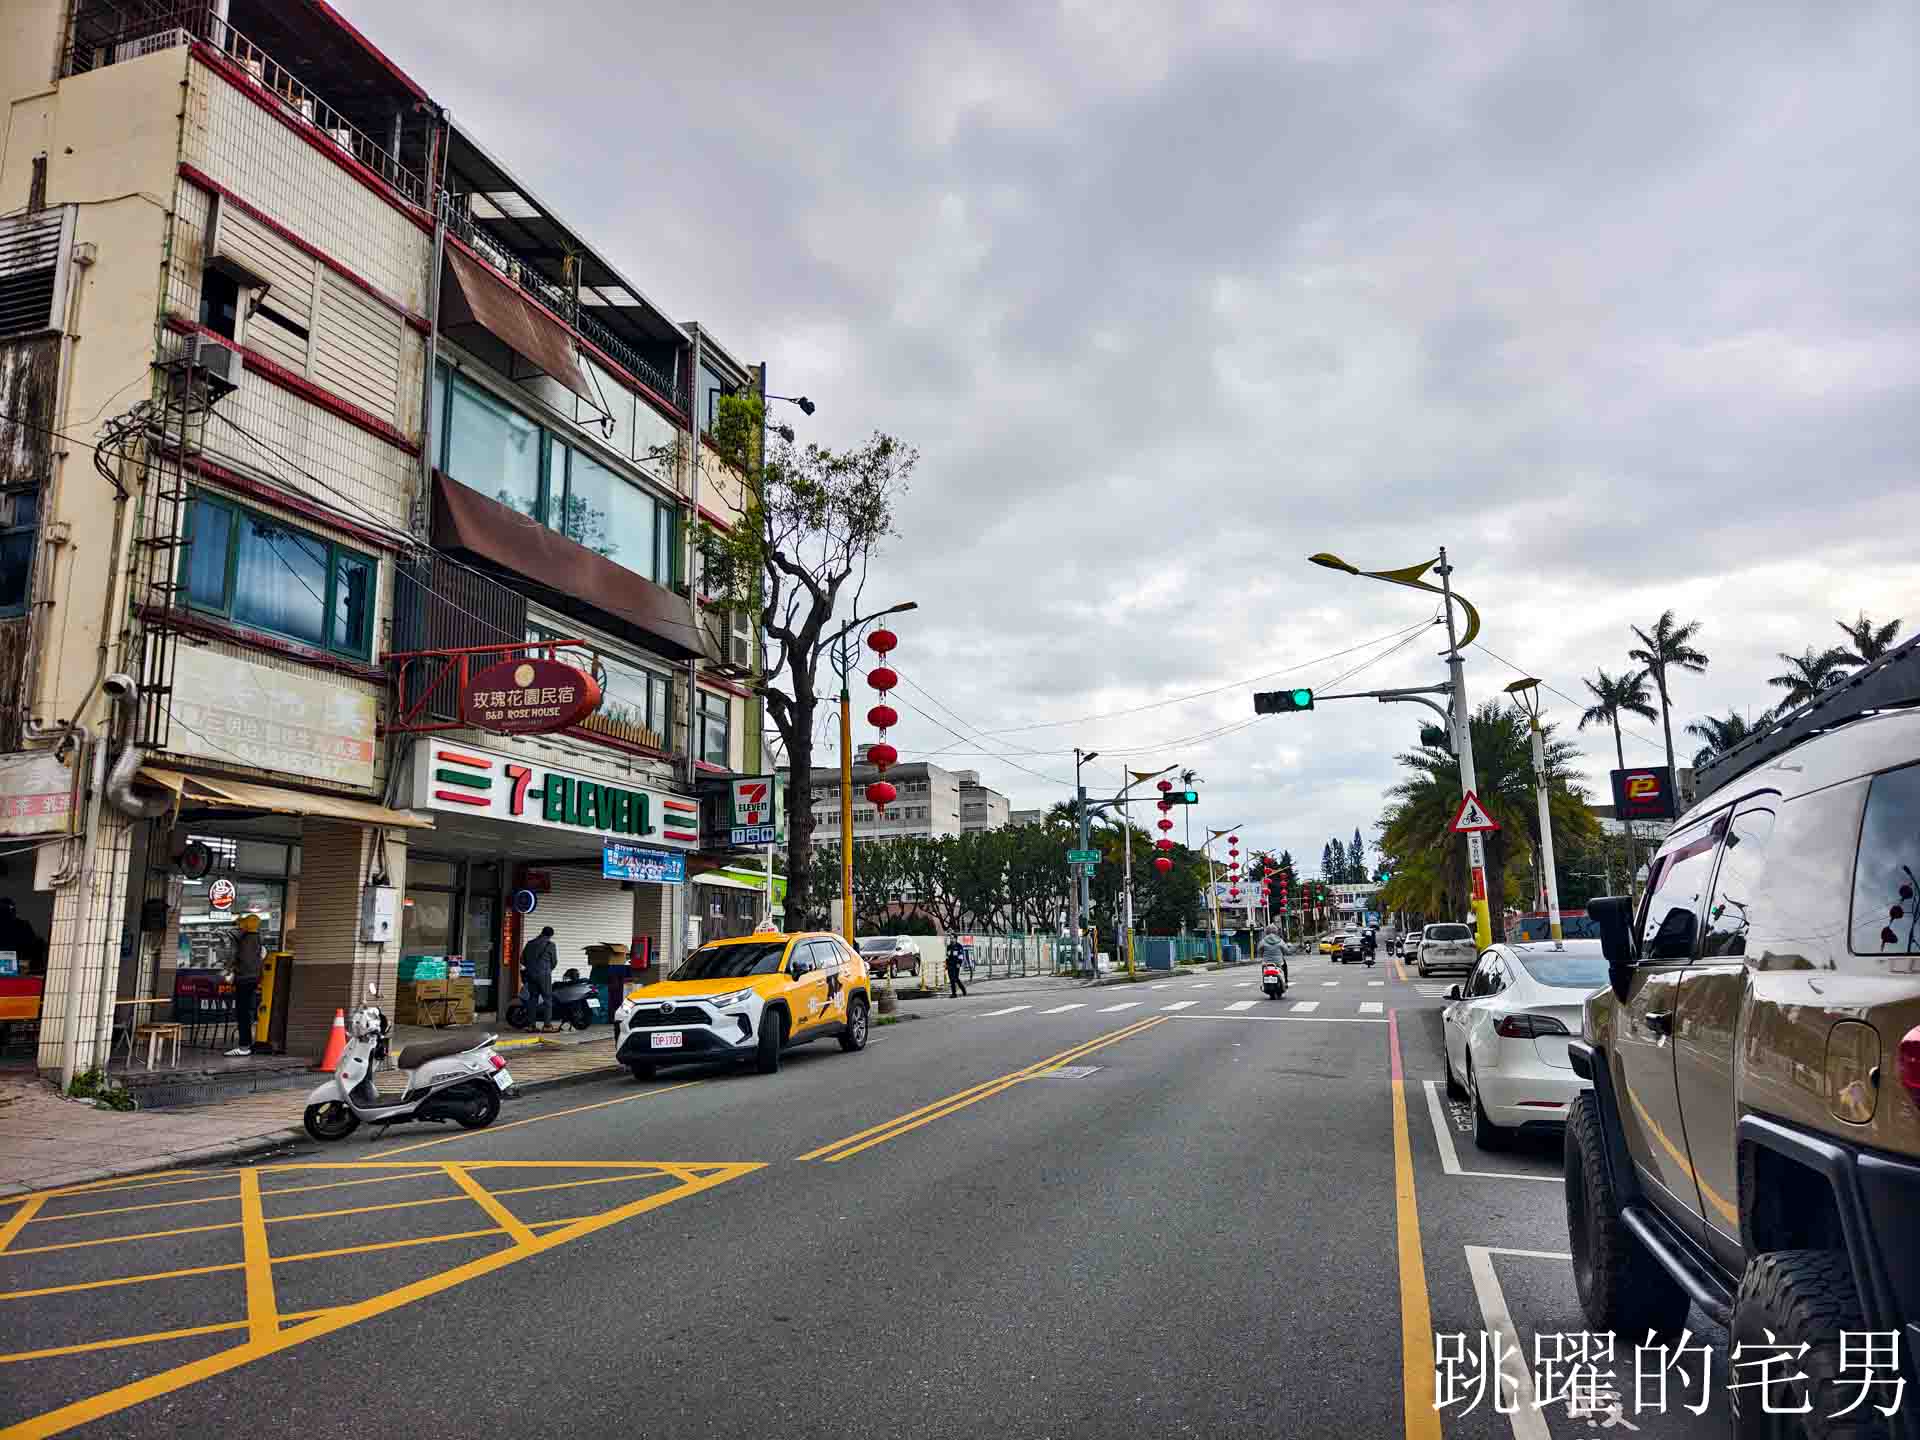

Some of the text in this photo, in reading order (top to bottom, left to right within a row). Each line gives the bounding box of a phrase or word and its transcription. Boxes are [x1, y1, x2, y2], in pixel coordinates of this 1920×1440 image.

[472, 686, 575, 709] 玫瑰花園民宿
[485, 707, 560, 720] B&B ROSE HOUSE
